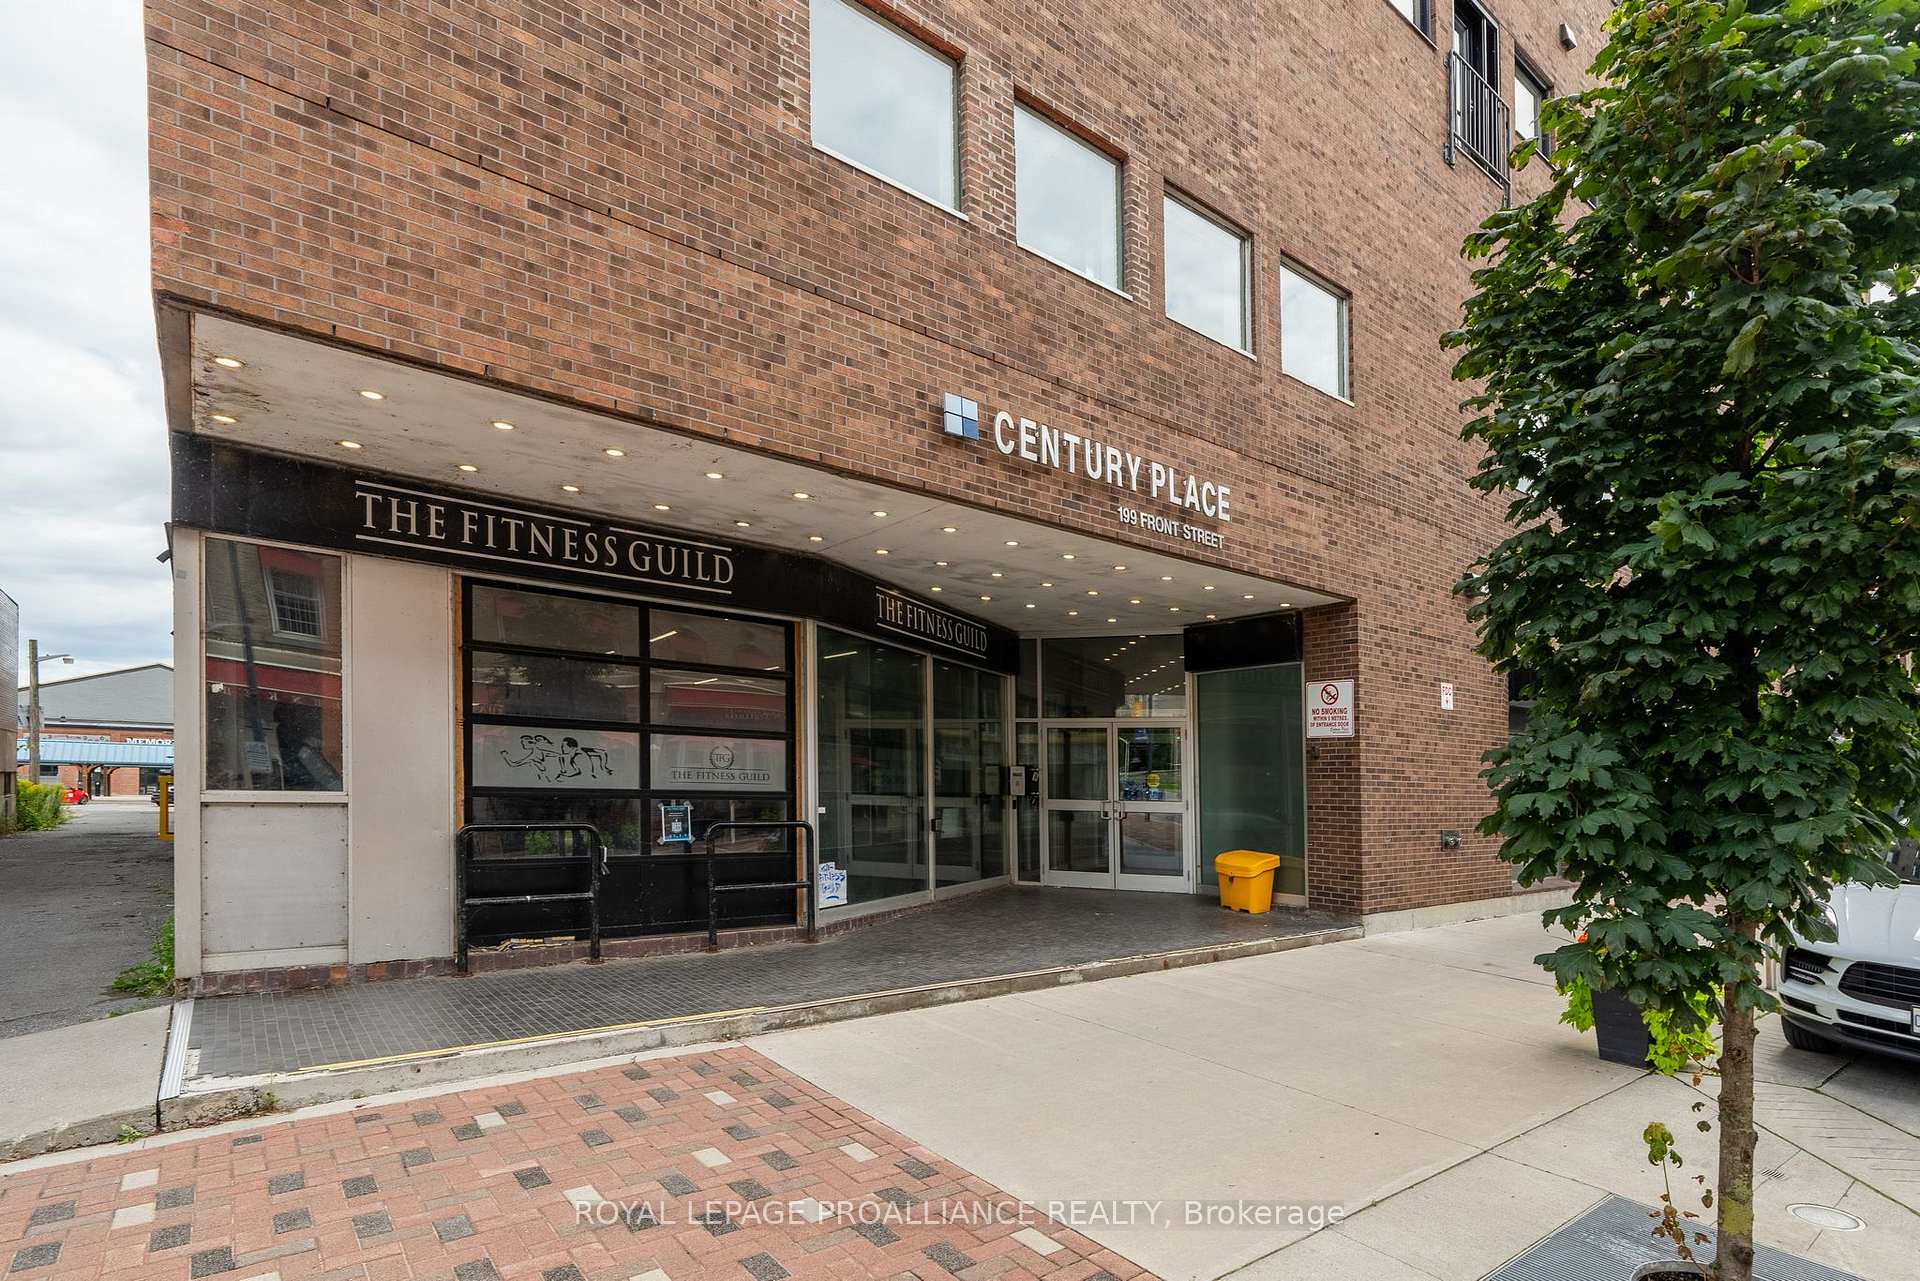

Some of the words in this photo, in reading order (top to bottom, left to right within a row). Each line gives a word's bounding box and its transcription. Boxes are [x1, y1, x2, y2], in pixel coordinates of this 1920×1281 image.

[994, 411, 1142, 492] CENTURY
[1151, 461, 1232, 522] PLACE
[355, 491, 446, 540] THE
[460, 510, 617, 567] FITNESS
[628, 540, 734, 584] GUILD
[1118, 506, 1137, 525] 199
[1140, 513, 1180, 537] FRONT
[1183, 523, 1225, 549] STREET
[876, 593, 903, 625] THE
[906, 604, 953, 641] FITNESS
[955, 622, 987, 652] GUILD
[1311, 707, 1320, 716] NO
[1321, 707, 1348, 716] SMOKING
[672, 770, 692, 780] THE
[696, 771, 735, 780] FITNESS
[739, 772, 770, 781] GUILD
